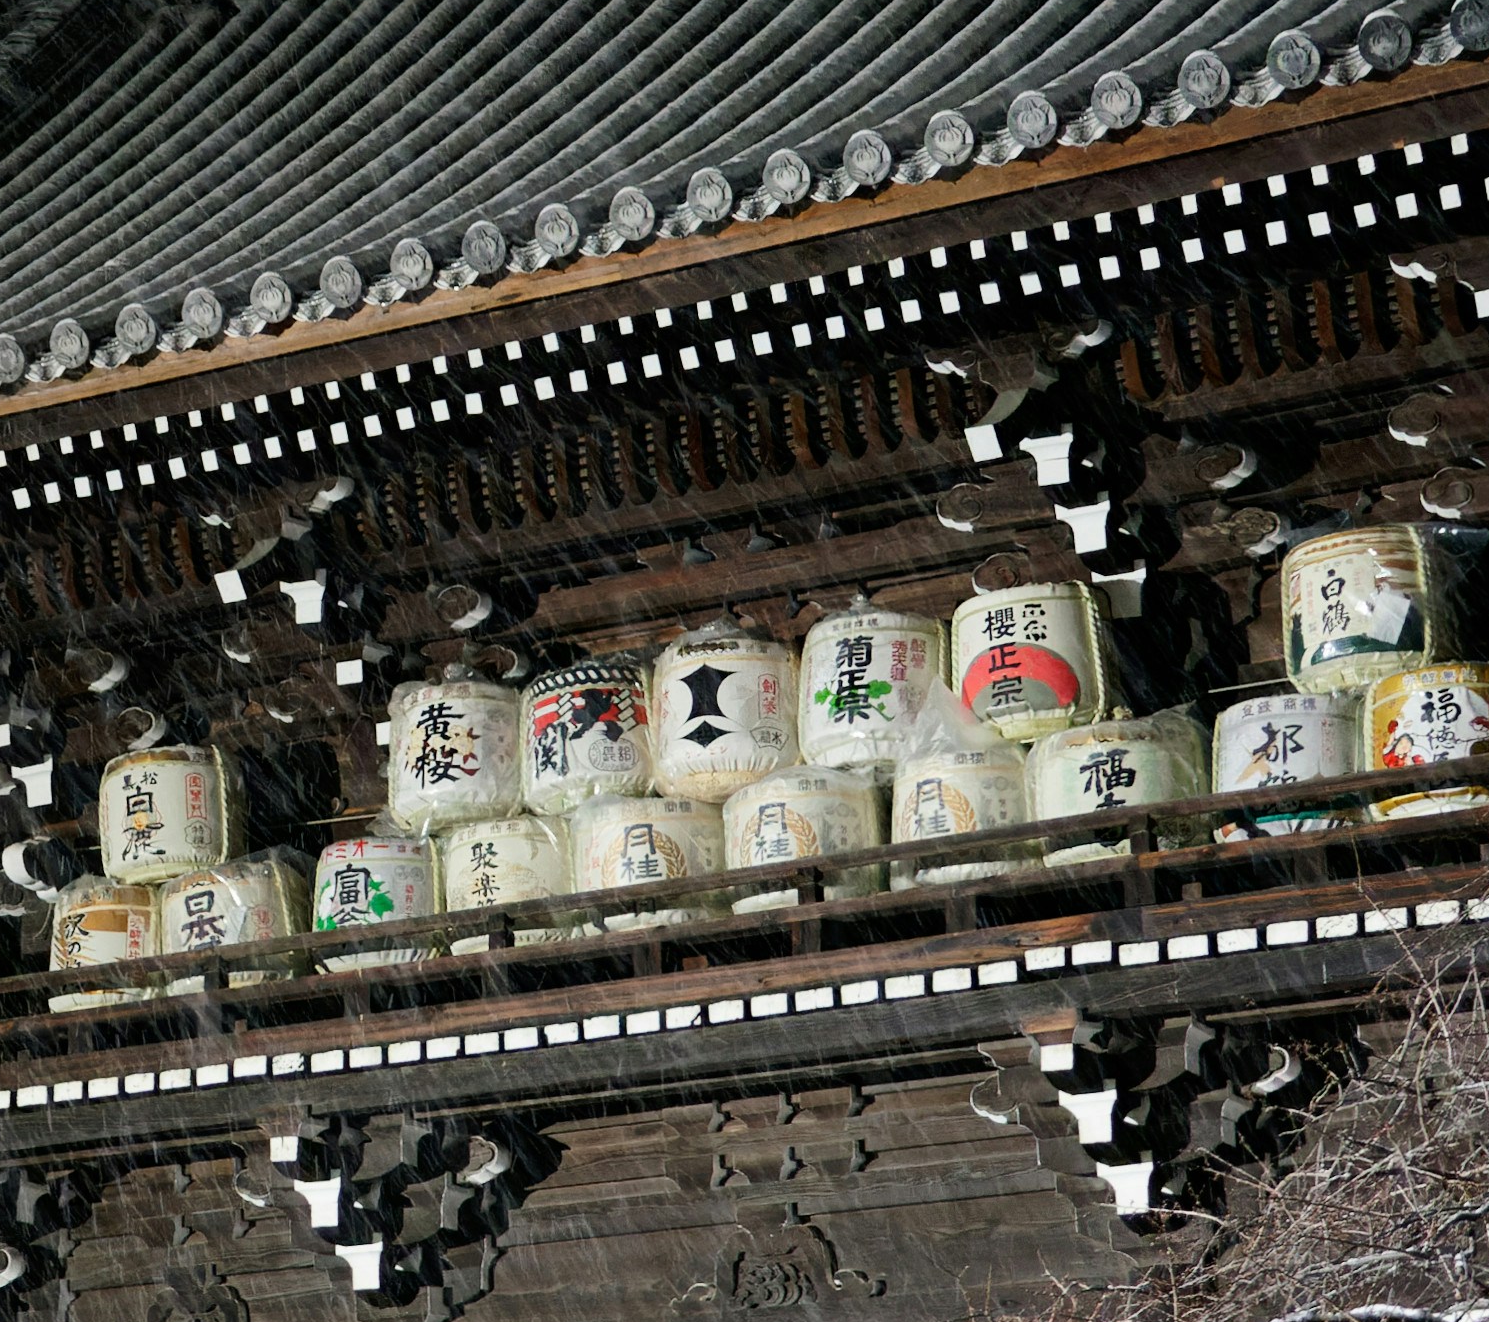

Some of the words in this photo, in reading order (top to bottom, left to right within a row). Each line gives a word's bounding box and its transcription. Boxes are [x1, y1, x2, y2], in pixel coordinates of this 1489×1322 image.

[1321, 569, 1351, 635] 白鶴
[834, 635, 874, 724] 菊正宗
[982, 606, 1025, 707] 櫻正宗
[415, 702, 466, 789] 黄桜
[122, 785, 166, 861] 白鹿
[620, 823, 663, 882] 月桂
[181, 890, 226, 950] 日本
